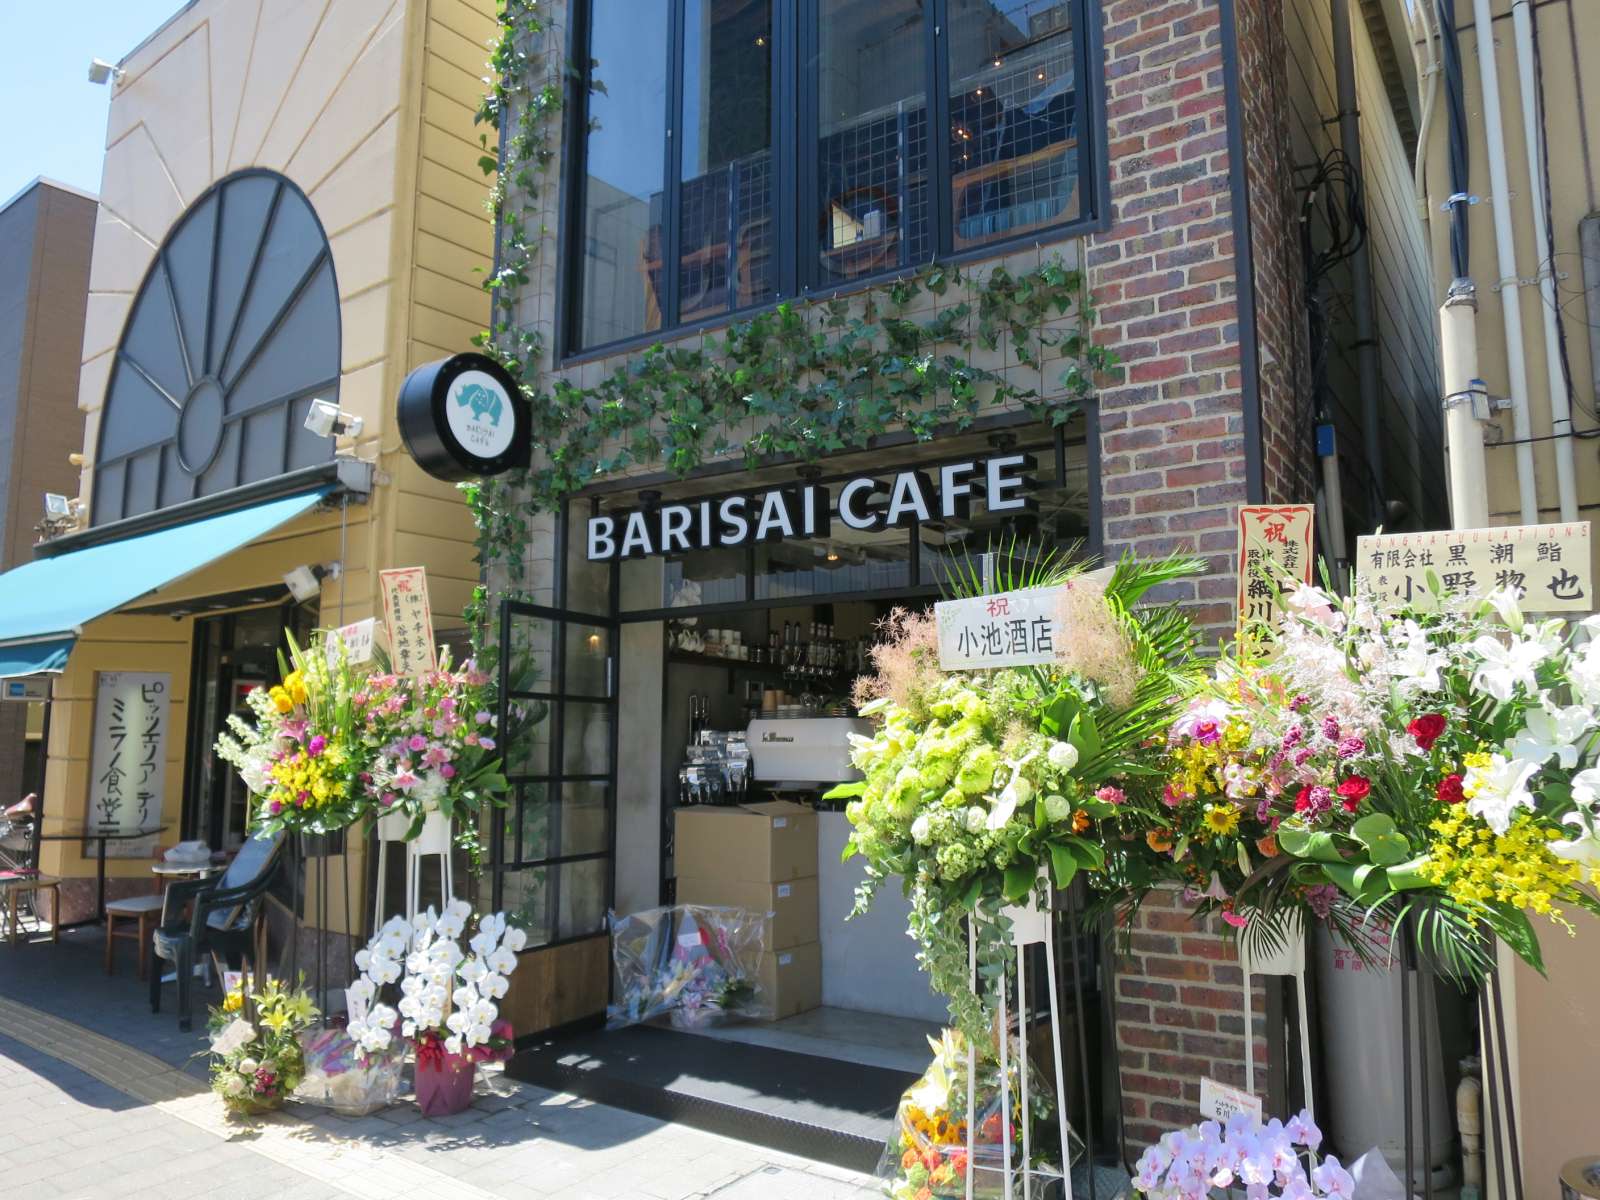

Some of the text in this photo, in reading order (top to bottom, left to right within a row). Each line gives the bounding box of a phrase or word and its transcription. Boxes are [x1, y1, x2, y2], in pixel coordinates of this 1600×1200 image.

[587, 455, 1026, 560] BARISAI CAFE
[1264, 522, 1287, 544] 祝
[1370, 548, 1435, 569] 有限会社
[986, 597, 1010, 617] 祝
[958, 615, 1053, 658] 小池酒店
